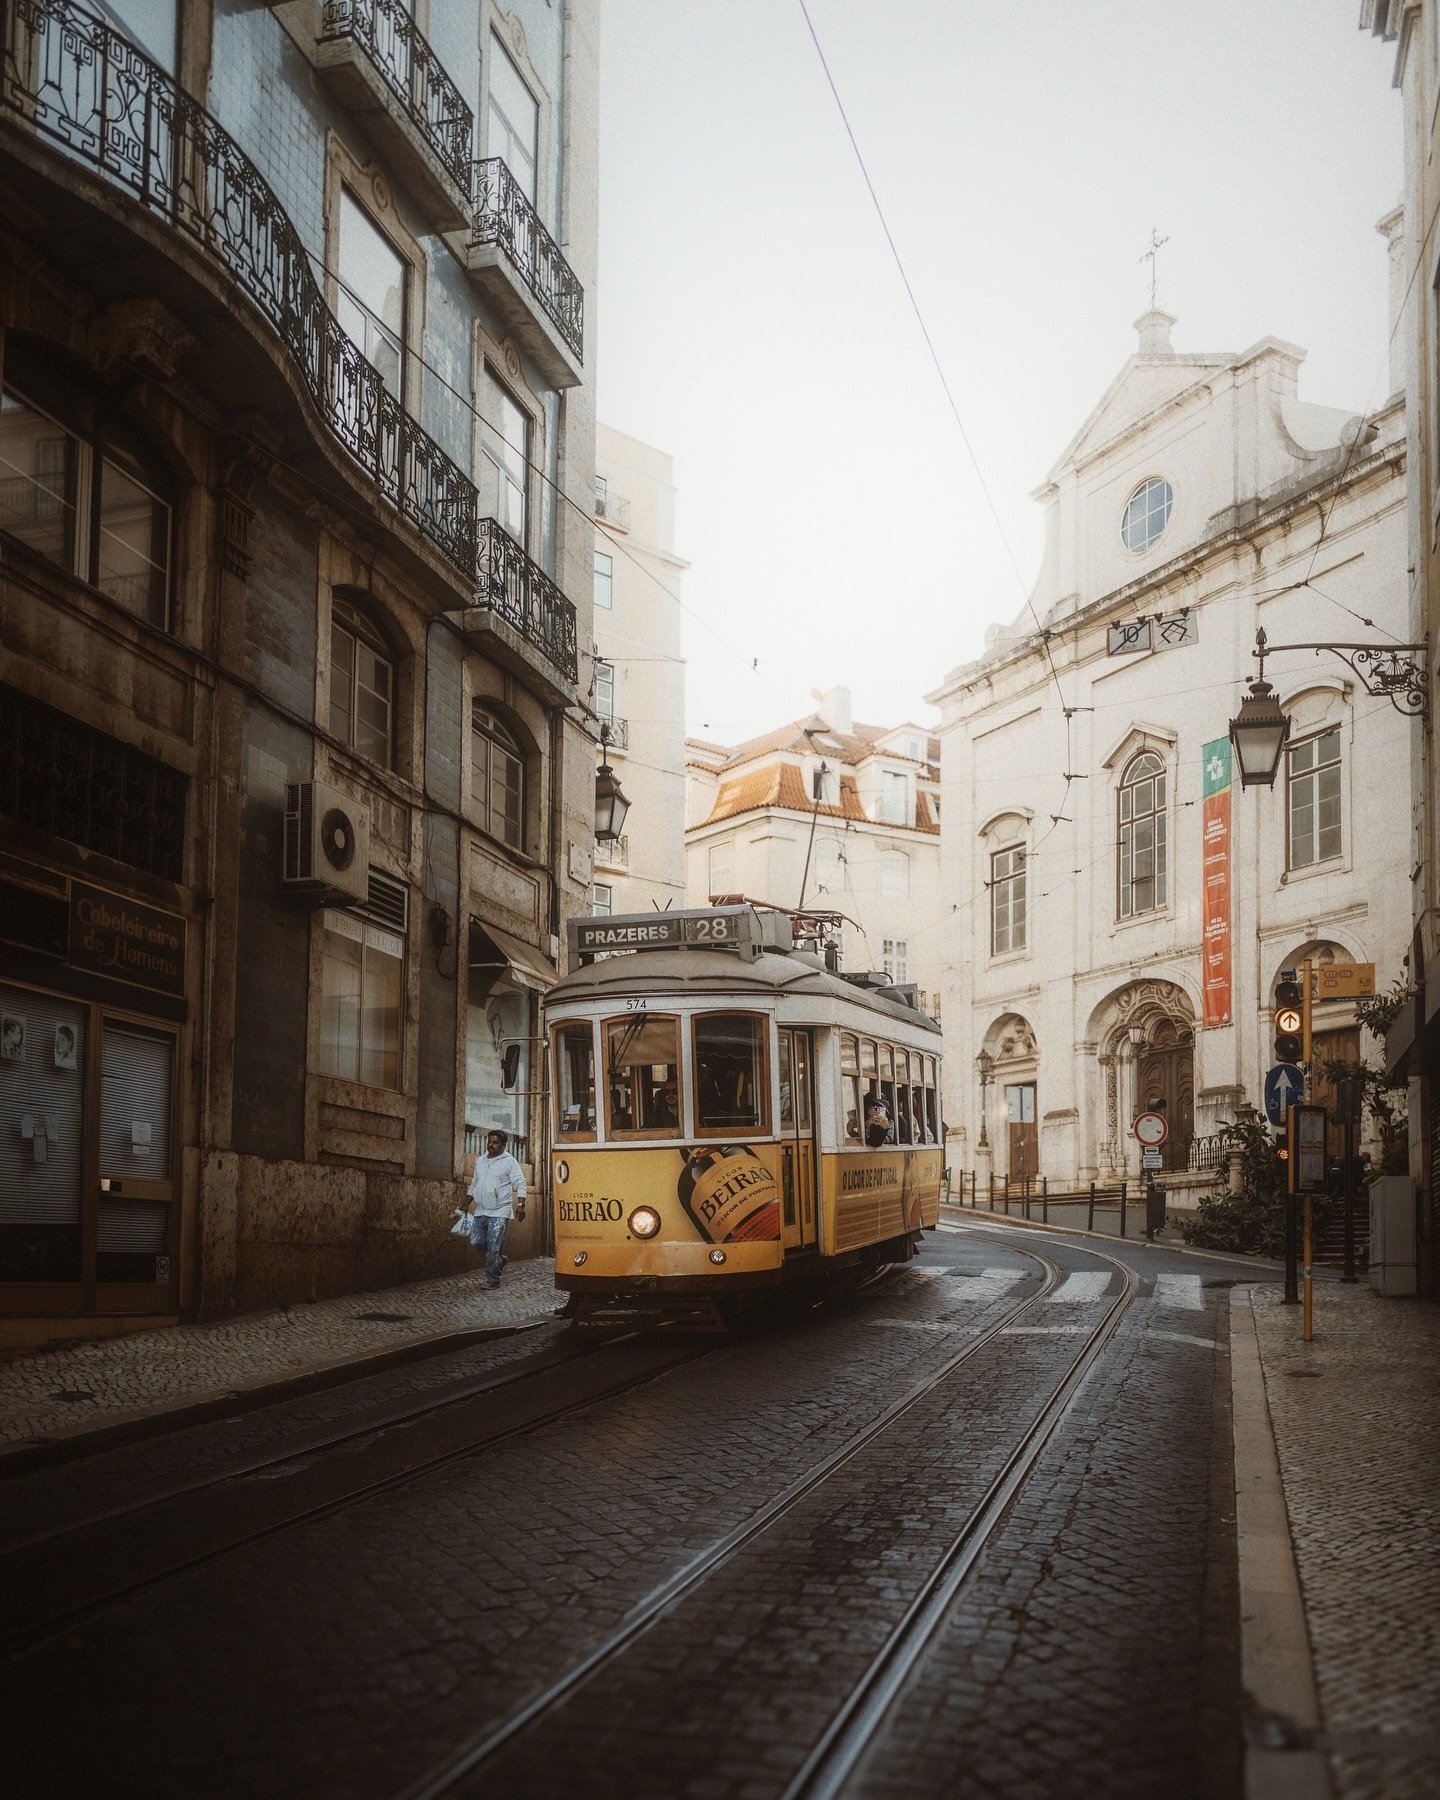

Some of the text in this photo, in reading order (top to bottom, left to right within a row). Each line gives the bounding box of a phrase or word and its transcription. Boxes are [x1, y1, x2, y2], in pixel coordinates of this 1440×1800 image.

[1119, 626, 1139, 643] 10
[78, 898, 178, 951] Cabeleireiro
[585, 917, 728, 945] PRAZERES 28
[83, 928, 177, 976] de Homens
[626, 999, 647, 1011] 574
[716, 1166, 744, 1183] LICOR
[842, 1170, 848, 1191] O
[848, 1169, 865, 1191] LICOR
[865, 1168, 873, 1188] DE
[873, 1166, 898, 1187] PORTUGAL
[699, 1166, 774, 1224] BEIRÃO
[558, 1197, 624, 1222] BEIRÃO
[720, 1204, 739, 1223] LICOR
[738, 1196, 750, 1205] DE
